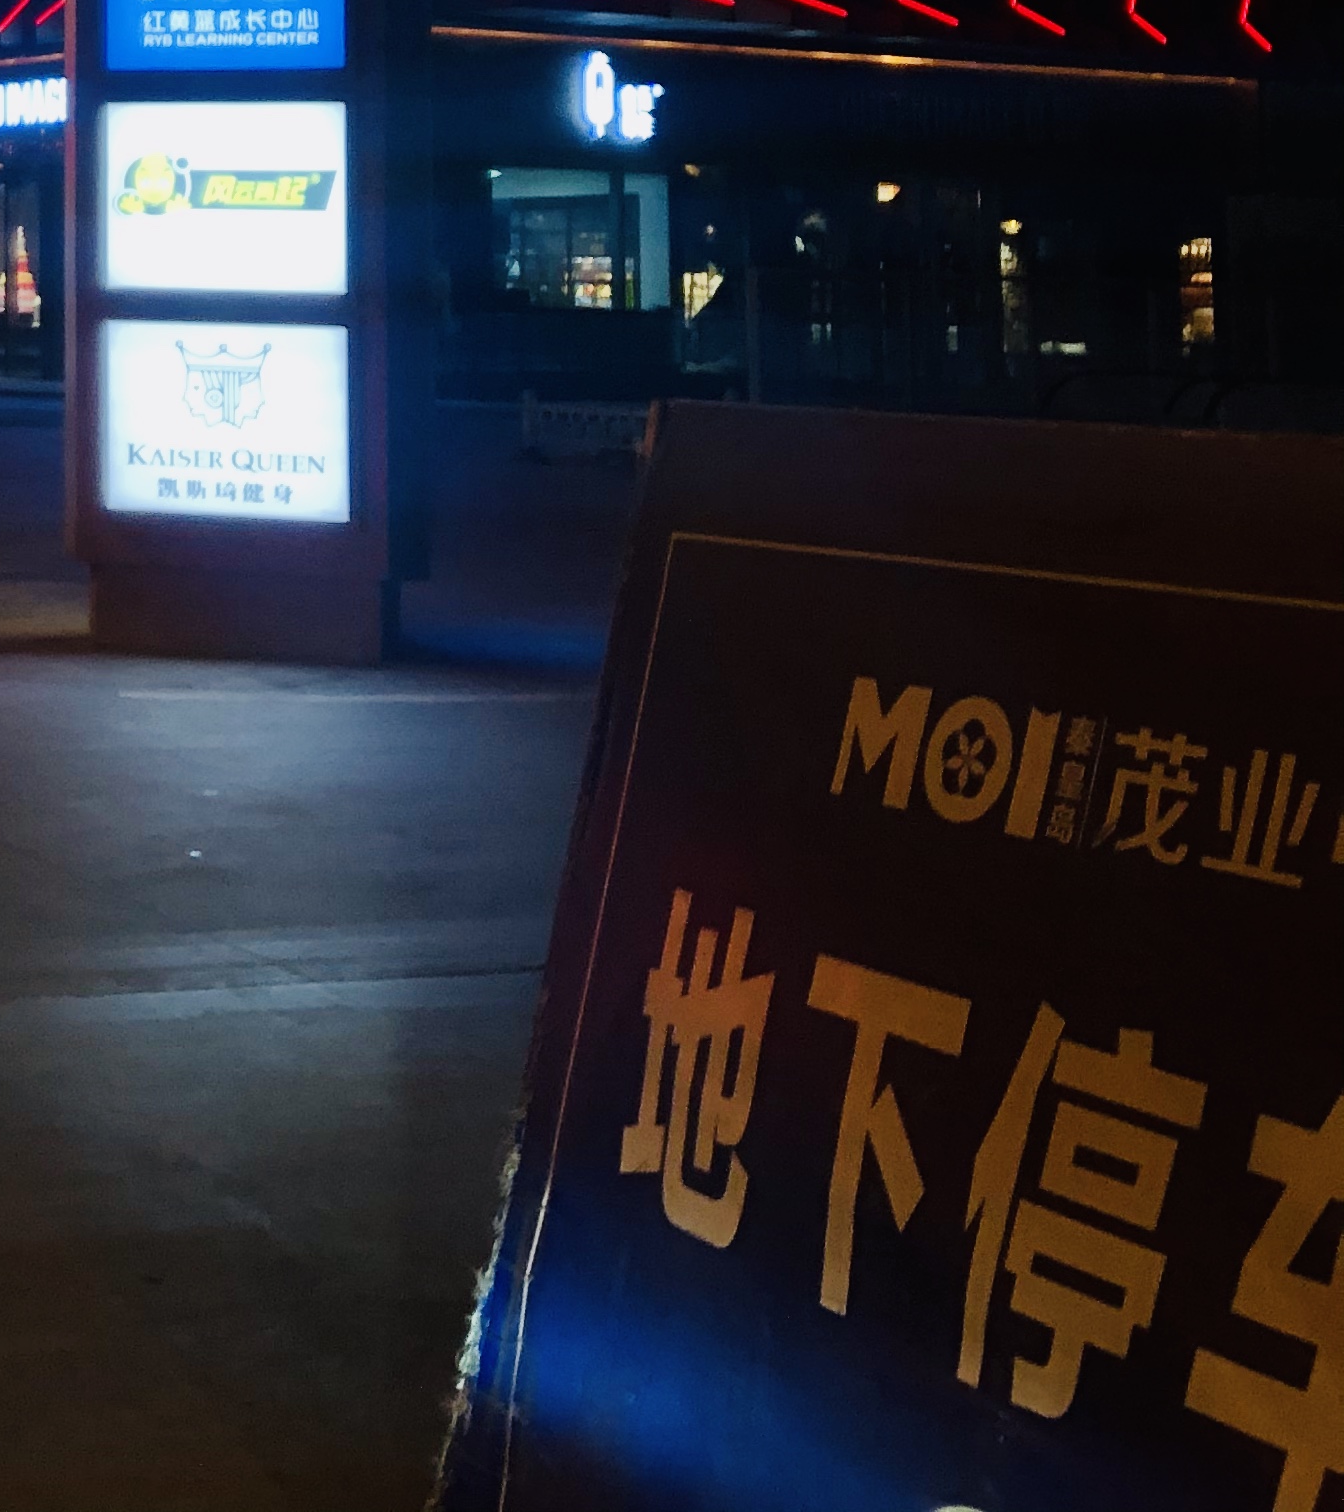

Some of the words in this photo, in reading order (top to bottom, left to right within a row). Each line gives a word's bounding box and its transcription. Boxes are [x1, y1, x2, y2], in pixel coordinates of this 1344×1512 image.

[143, 9, 319, 33] 红黄蓝成长中心
[143, 33, 172, 47] RYB
[177, 32, 253, 47] LEARNING
[256, 31, 319, 46] CENTER
[127, 443, 224, 469] KAISER
[231, 449, 325, 474] QUEEN
[830, 676, 1062, 840] MOI
[1092, 726, 1344, 890] 茂业
